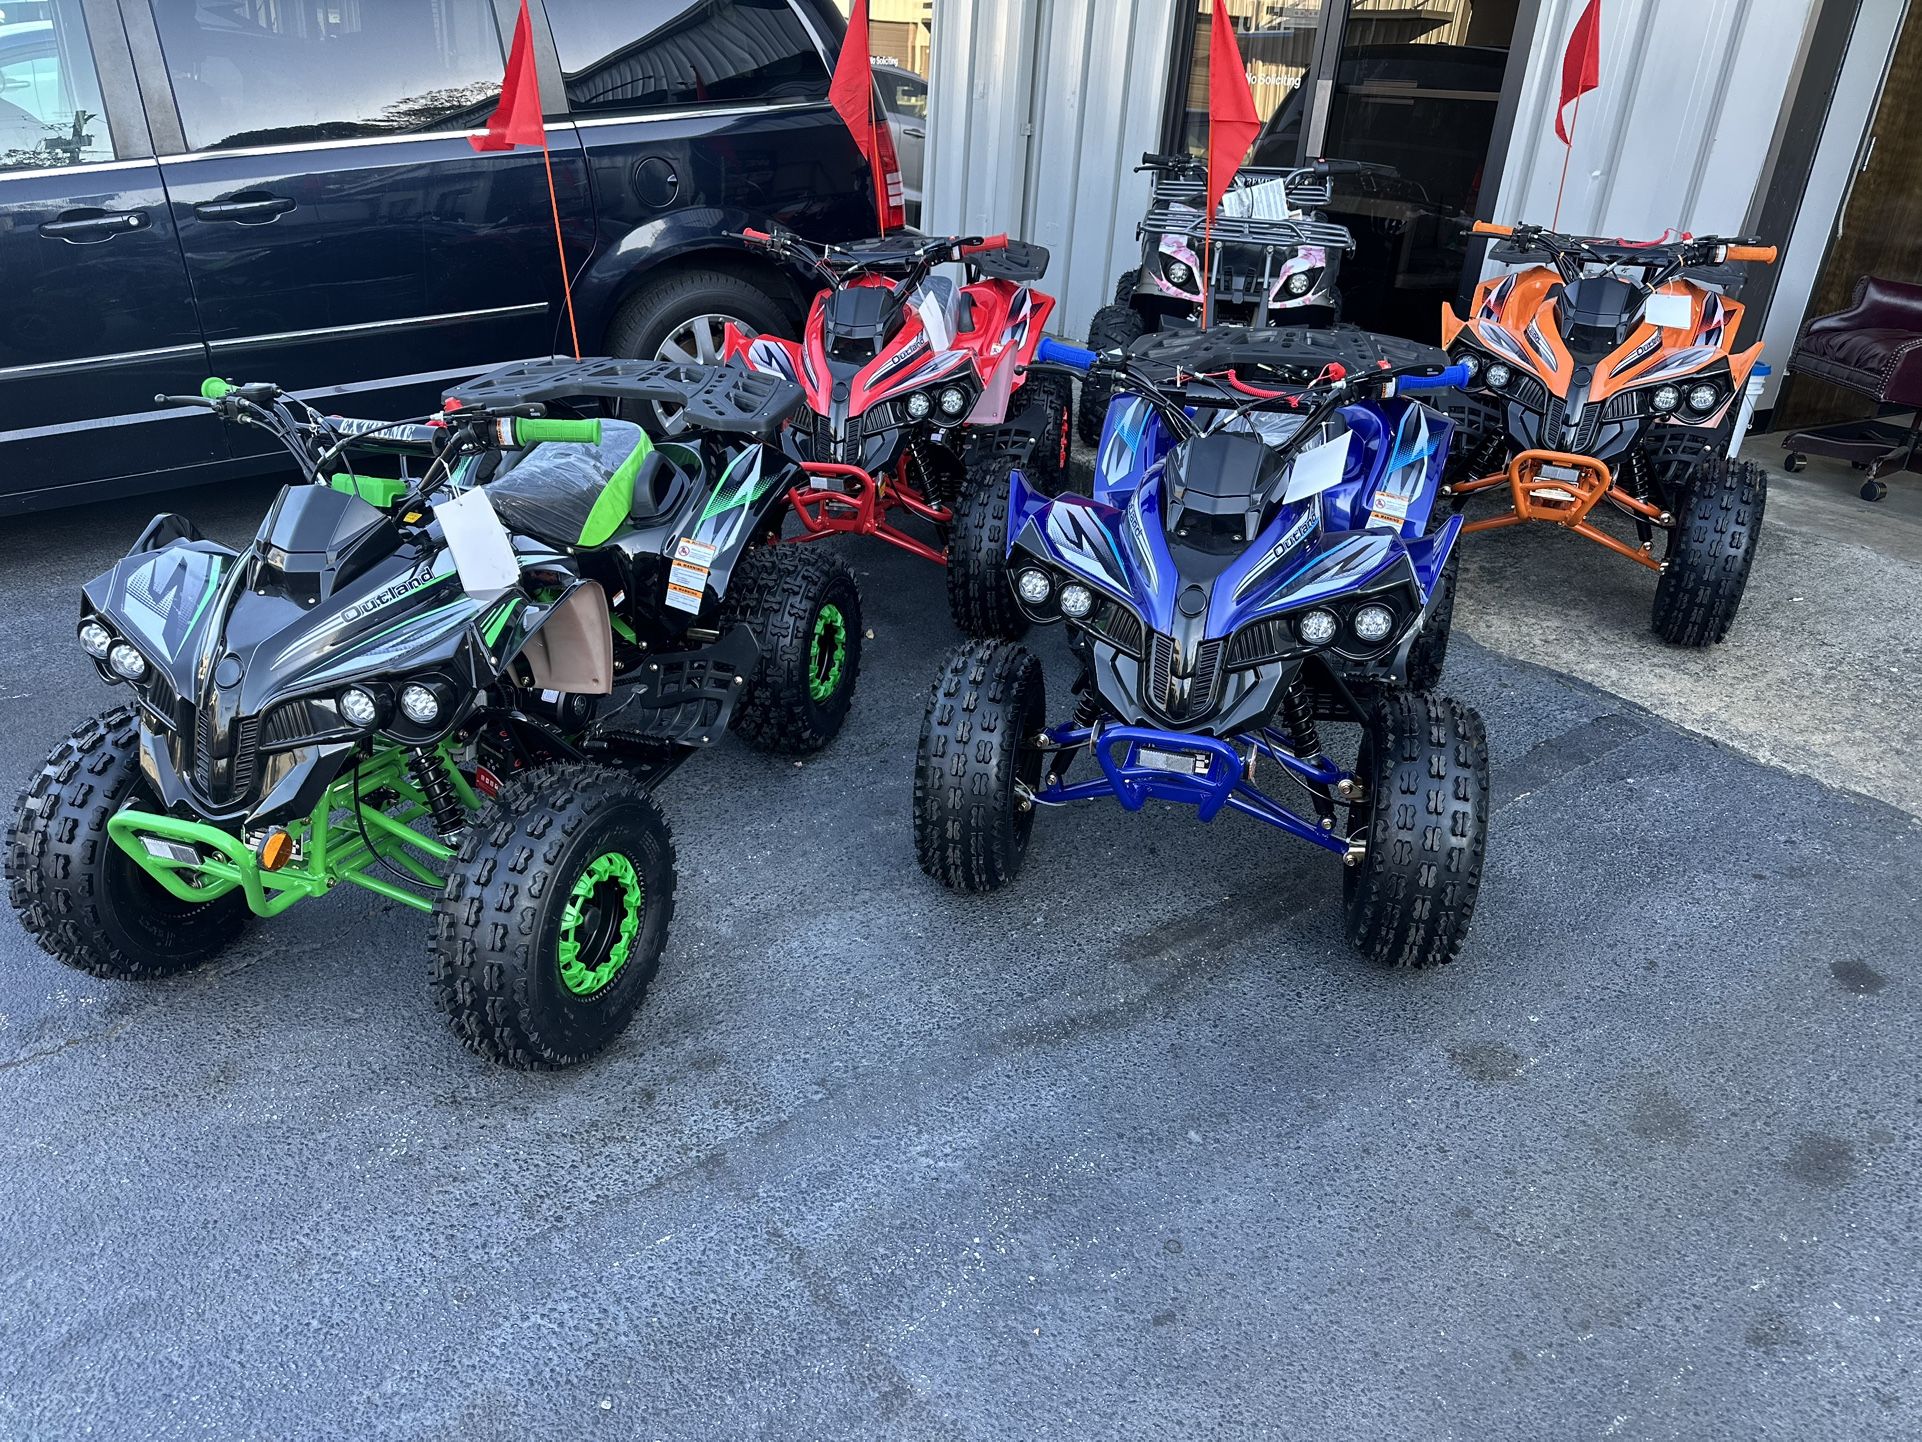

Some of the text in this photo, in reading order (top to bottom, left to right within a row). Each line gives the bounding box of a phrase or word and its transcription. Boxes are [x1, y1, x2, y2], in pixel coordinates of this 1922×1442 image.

[1260, 73, 1301, 89] Soliciting
[339, 417, 416, 441] EXTREME
[340, 565, 435, 623] Outland
